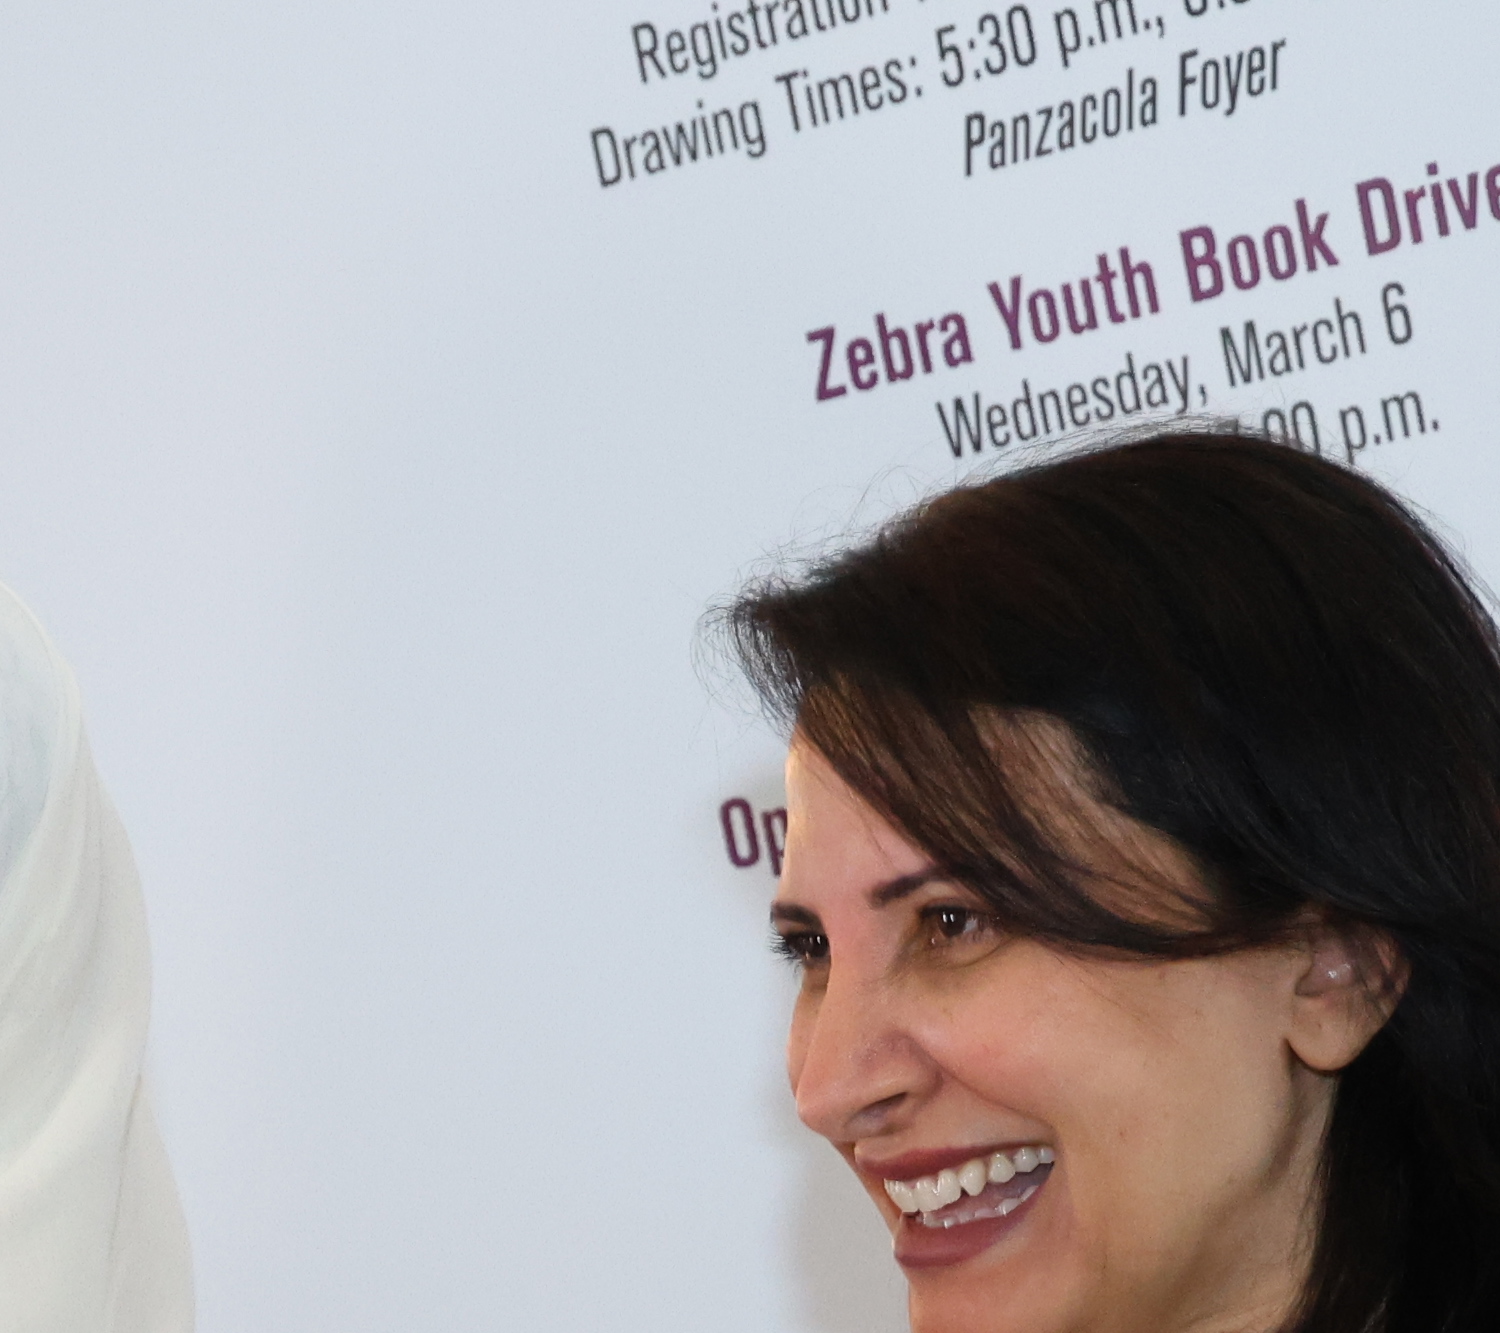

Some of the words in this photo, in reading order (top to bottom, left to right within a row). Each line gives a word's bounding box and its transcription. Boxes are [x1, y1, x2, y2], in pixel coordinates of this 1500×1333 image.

[590, 98, 767, 188] Drawing
[775, 56, 924, 134] Times:
[935, 3, 1038, 88] 5:30
[964, 68, 1159, 177] Panzacola
[1178, 38, 1288, 118] Foyer
[806, 311, 975, 402] Zebra
[986, 245, 1161, 350] Youth
[1177, 197, 1341, 303] Book
[936, 352, 1208, 458] Wednesday,
[1219, 295, 1369, 390] March
[1380, 281, 1414, 345] 6
[1339, 390, 1440, 466] p.m.
